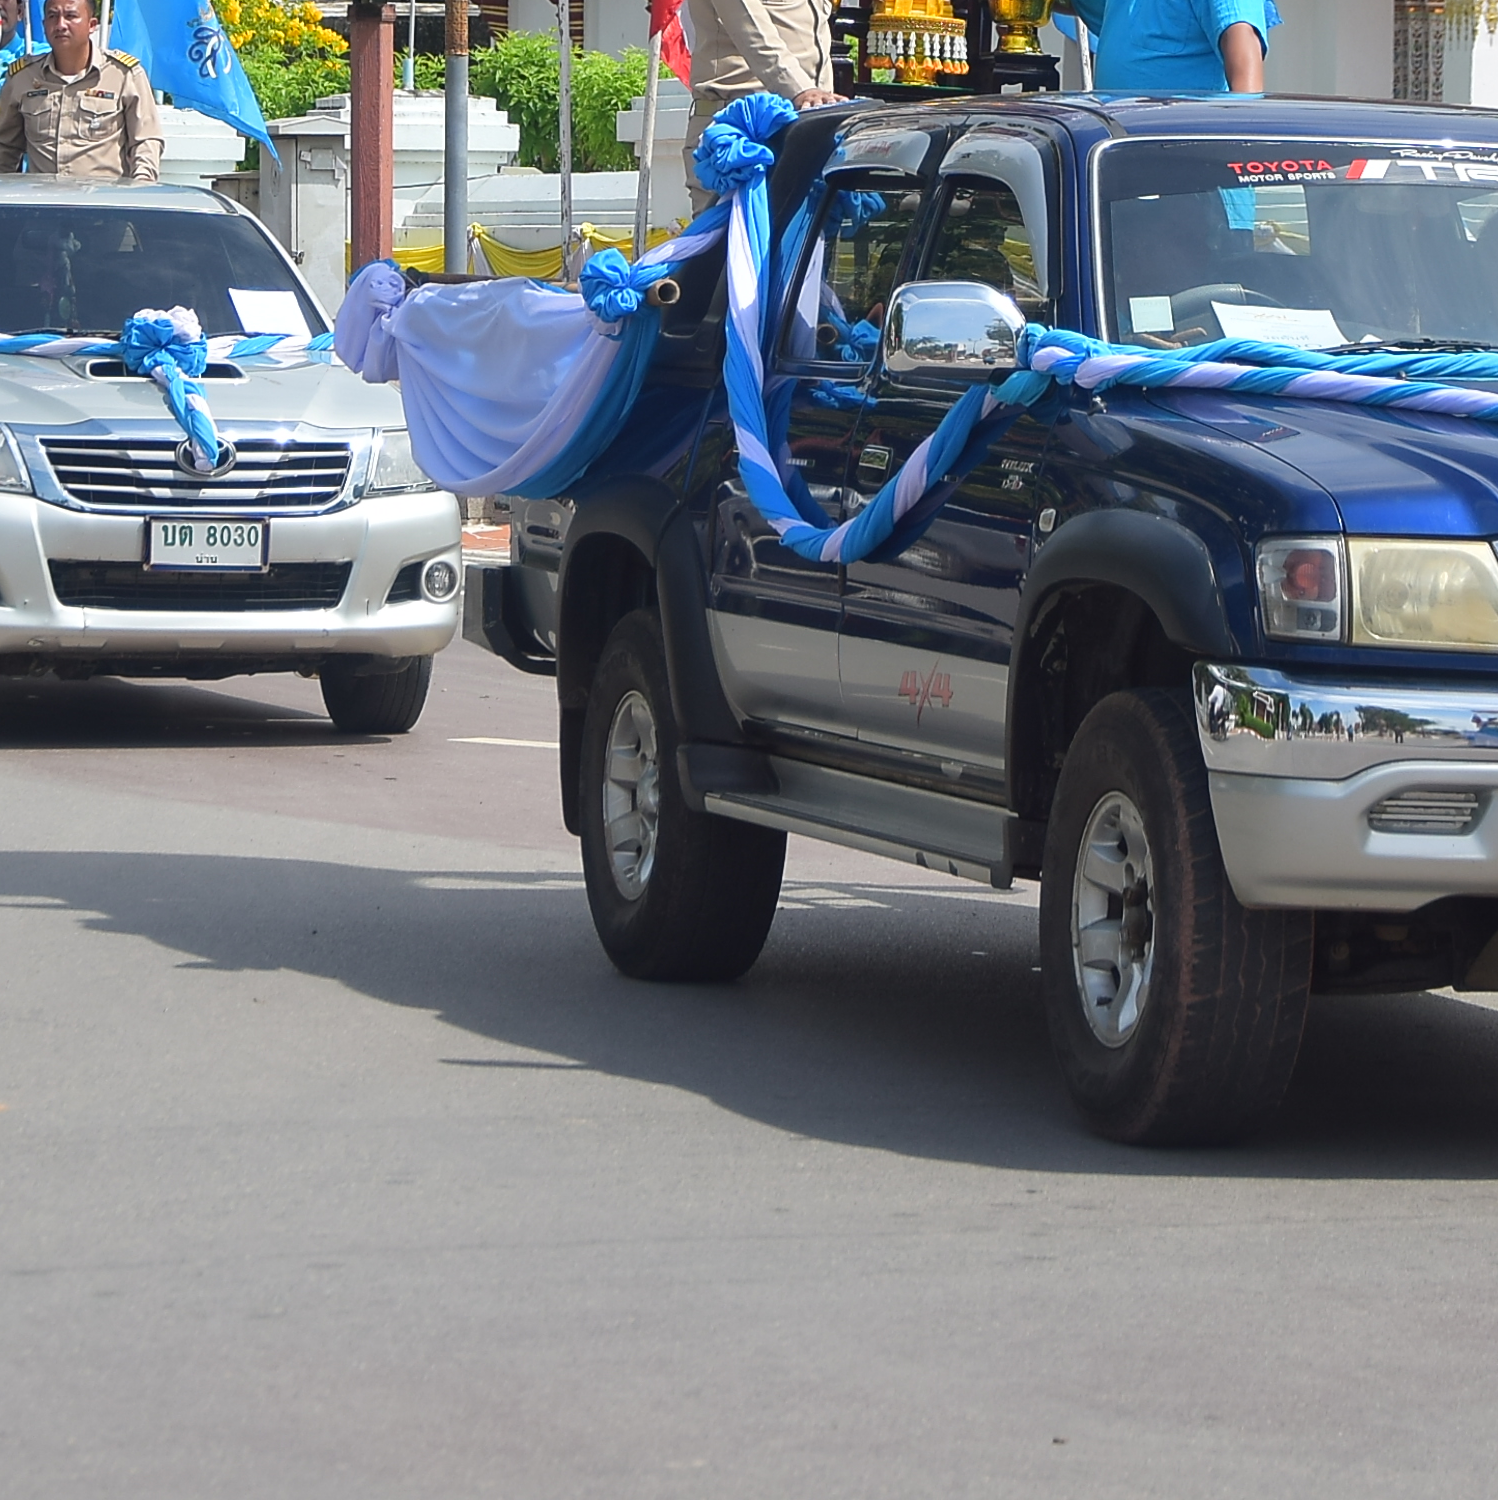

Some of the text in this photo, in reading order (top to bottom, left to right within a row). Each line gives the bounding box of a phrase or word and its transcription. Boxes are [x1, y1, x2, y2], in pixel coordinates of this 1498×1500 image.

[1227, 160, 1333, 174] TOYOTA
[1238, 171, 1336, 183] MOTOR SPORTS
[161, 524, 259, 547] บต 8030
